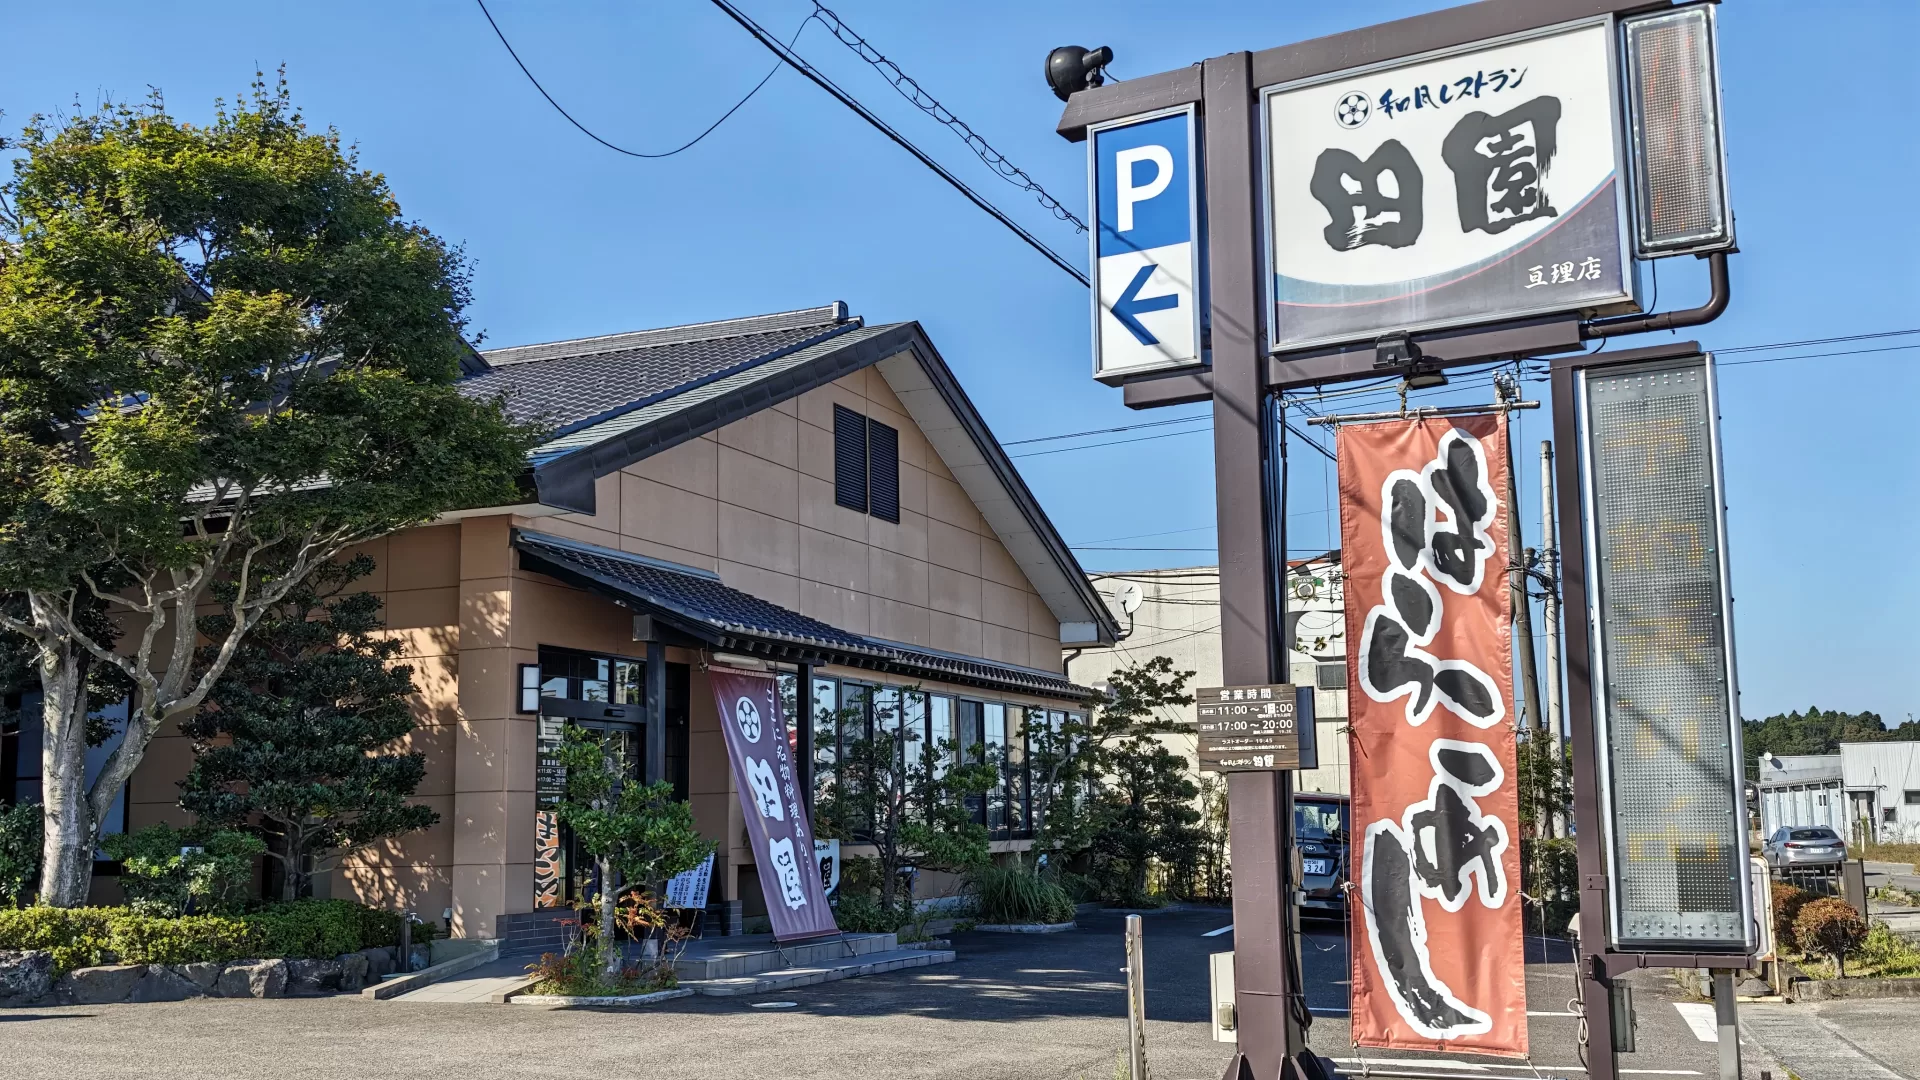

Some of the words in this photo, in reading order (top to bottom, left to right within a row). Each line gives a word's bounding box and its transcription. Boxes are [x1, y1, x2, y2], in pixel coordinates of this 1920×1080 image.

[1377, 66, 1528, 119] 和風レストラン
[1115, 143, 1175, 233] P
[1310, 95, 1561, 252] 田園
[1524, 257, 1601, 289] 亘理店
[1218, 706, 1247, 715] 11:00
[1220, 688, 1271, 700] 営業時間
[1218, 722, 1247, 731] 17:00
[1263, 720, 1293, 729] 20:00
[746, 755, 807, 911] 田園
